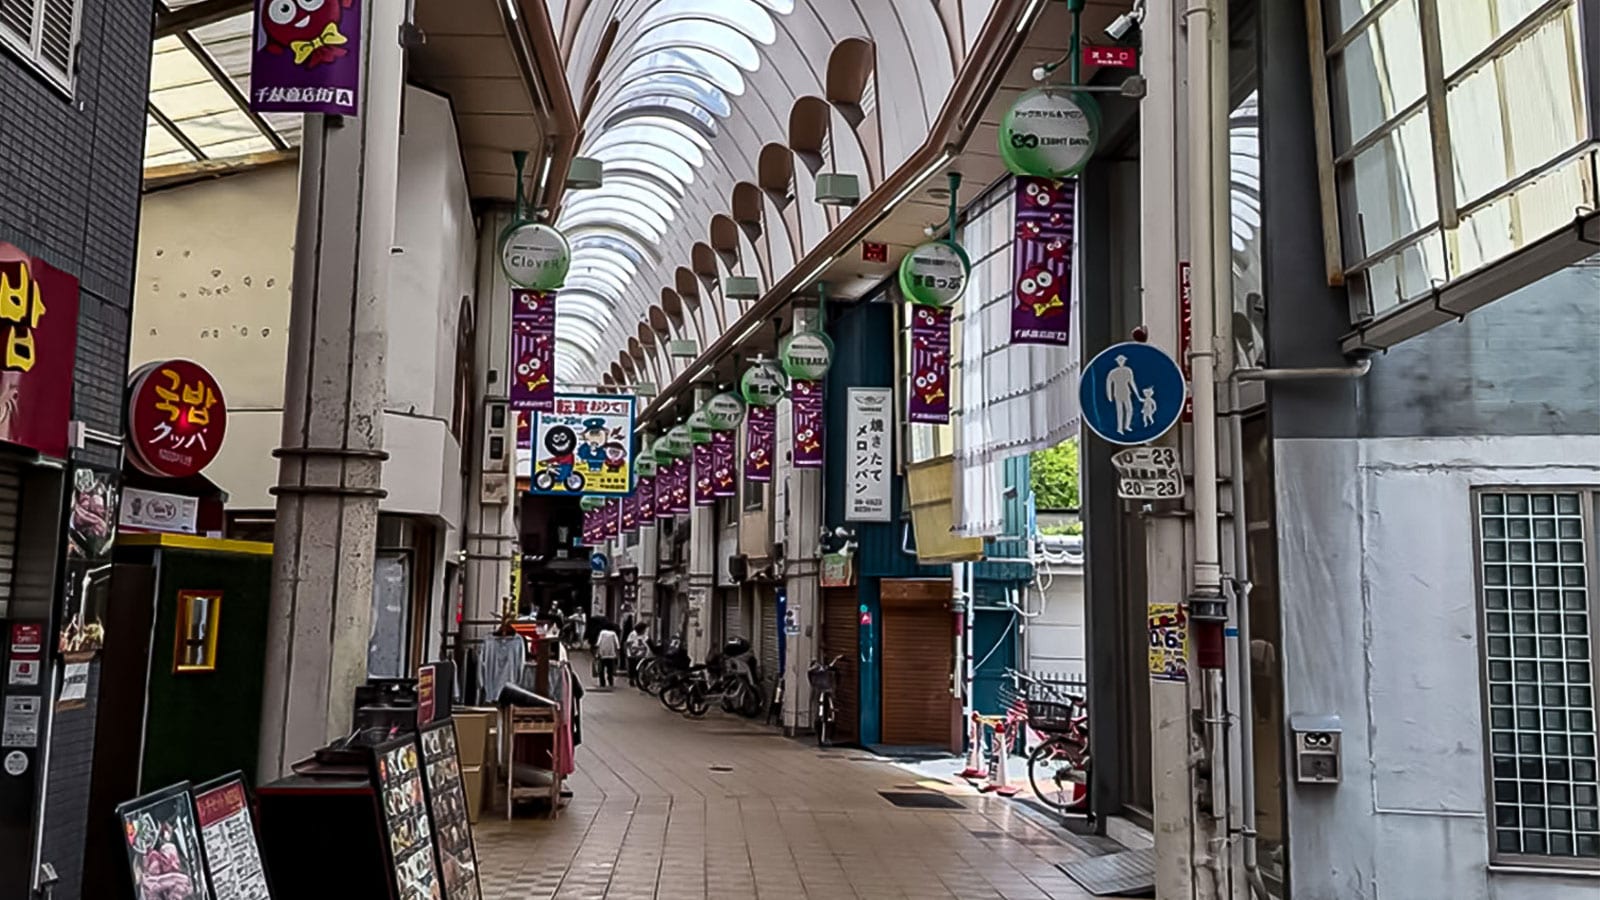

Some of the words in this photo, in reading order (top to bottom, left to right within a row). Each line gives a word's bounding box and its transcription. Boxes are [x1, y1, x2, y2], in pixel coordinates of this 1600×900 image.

[255, 87, 334, 103] 千林商店街
[155, 369, 217, 426] 국밥
[149, 421, 208, 451] クッパ
[870, 418, 884, 482] 焼きたて
